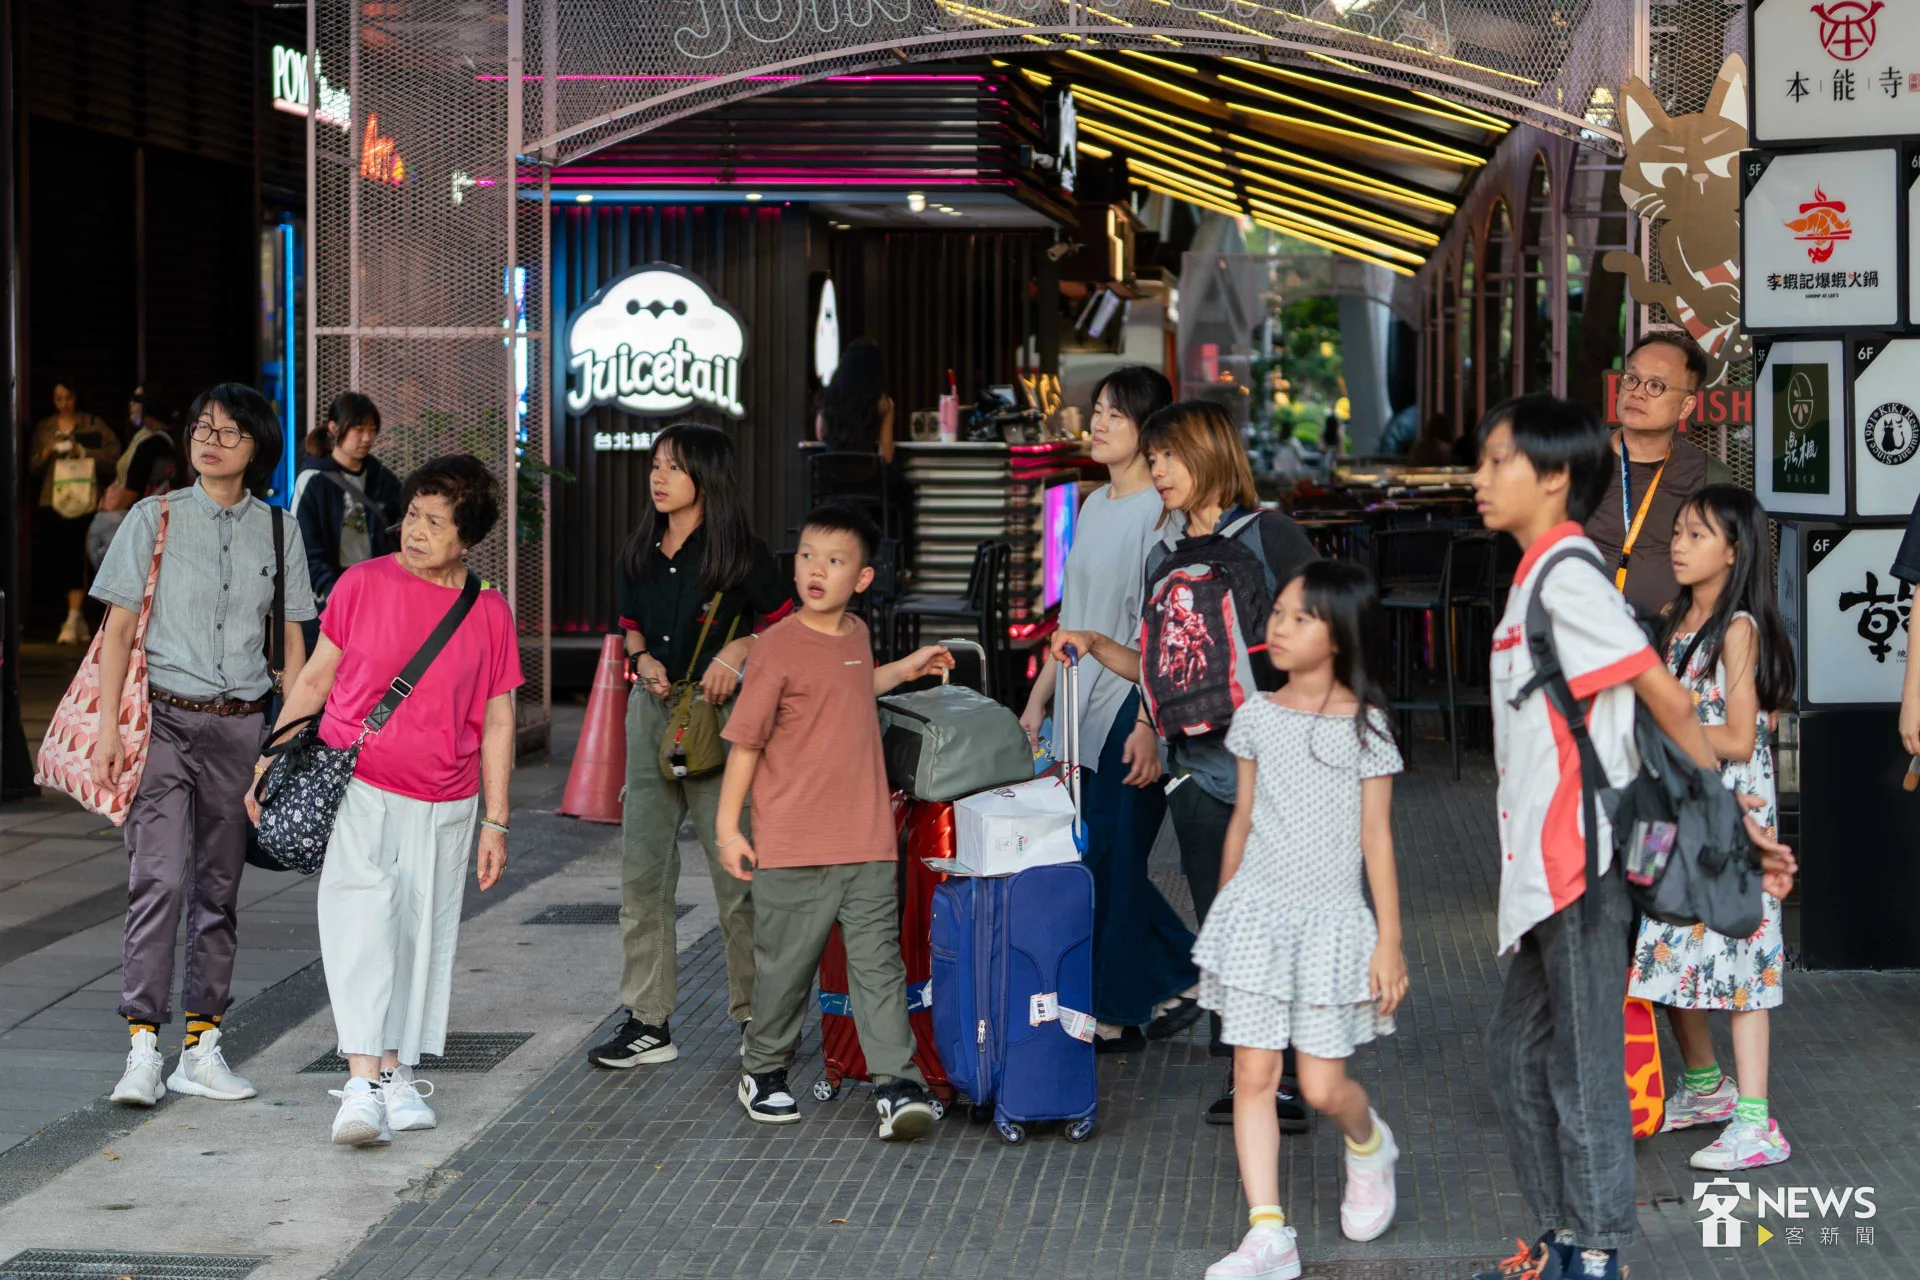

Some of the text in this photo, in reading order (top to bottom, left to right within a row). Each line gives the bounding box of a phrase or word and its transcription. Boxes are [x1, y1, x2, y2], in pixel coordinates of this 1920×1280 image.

[1749, 163, 1762, 177] 5F
[1766, 271, 1879, 291] 李蝦記爆蝦火鍋
[1757, 349, 1766, 362] 5F
[1857, 346, 1874, 361] 6F
[567, 338, 745, 417] Juicetail
[1878, 403, 1920, 462] KiKi Restaurant
[1869, 442, 1893, 465] Since
[1812, 538, 1830, 552] 6F
